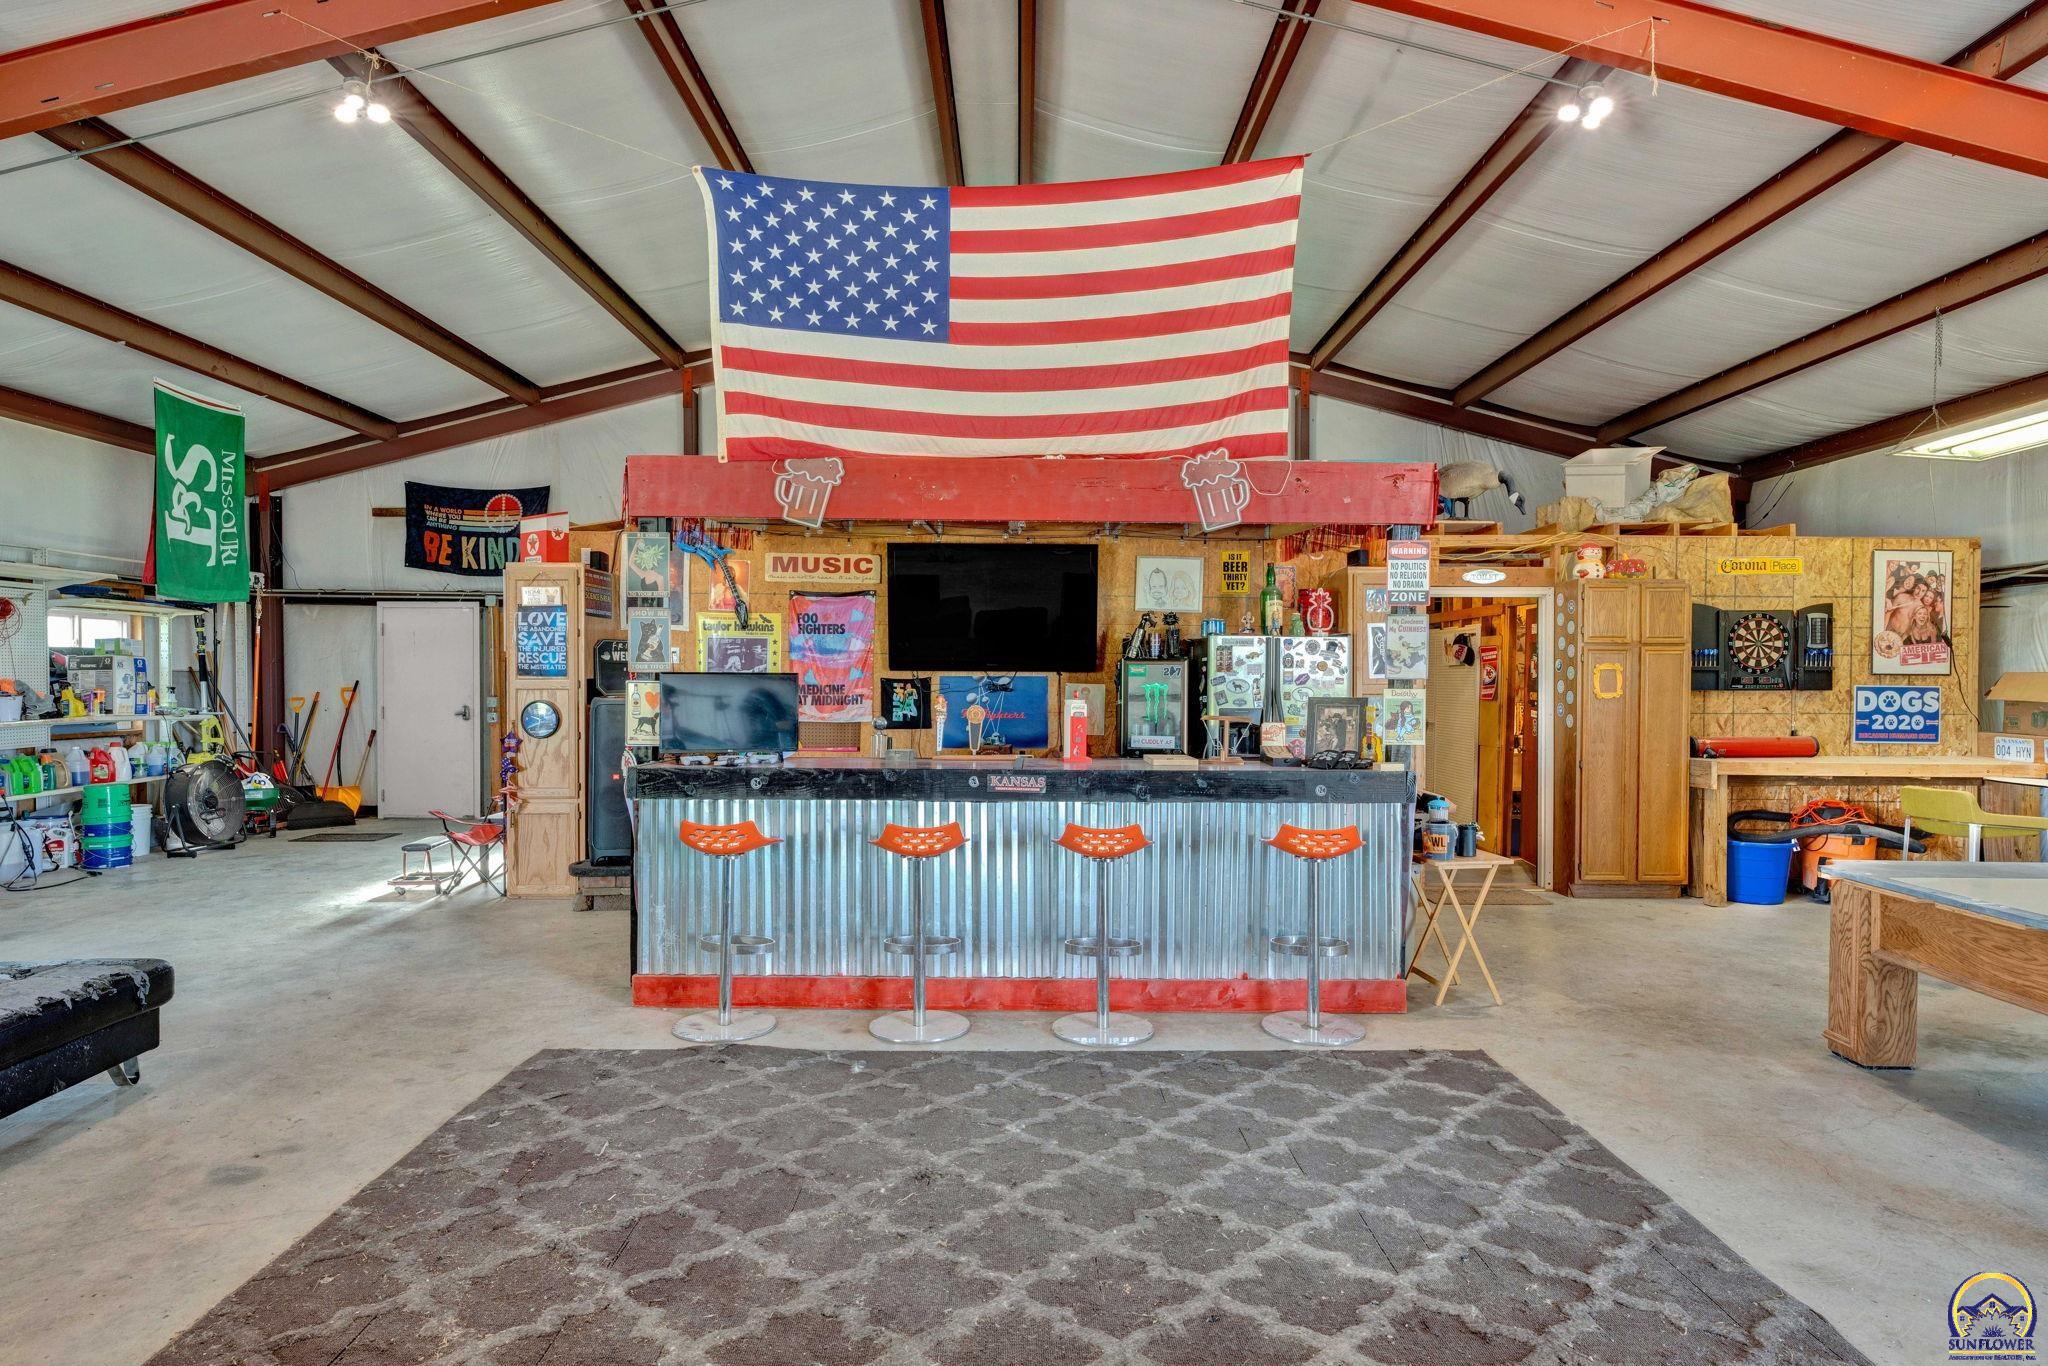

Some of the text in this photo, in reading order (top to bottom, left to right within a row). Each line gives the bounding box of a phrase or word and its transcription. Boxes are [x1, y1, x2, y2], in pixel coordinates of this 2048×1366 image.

[220, 449, 239, 567] MISSOURI
[440, 507, 463, 515] WORLD
[425, 510, 447, 518] WHERE
[426, 521, 458, 531] ANYTHING
[423, 530, 520, 570] BE KIND
[1390, 547, 1428, 555] WARNING
[1228, 553, 1243, 561] IS IT
[772, 556, 874, 575] MUSIC
[1222, 562, 1248, 572] BEER
[1390, 562, 1427, 571] NO POLITICS
[1721, 559, 1797, 574] Corona Place
[1223, 573, 1248, 581] THIRTY
[1390, 571, 1427, 580] NO RELIGION
[1226, 581, 1246, 591] YET?
[1392, 580, 1424, 589] NO DRAMA
[1390, 591, 1427, 602] ZONE
[518, 611, 567, 626] LOVE
[797, 613, 819, 624] FOO
[703, 621, 731, 633] taylor
[797, 624, 846, 635] FIGHTERS
[1397, 625, 1427, 633] GUINNESS
[517, 632, 566, 646] SAVE
[1902, 643, 1947, 655] AMERICAN
[518, 652, 567, 664] RESCUE
[1901, 651, 1948, 665] PIE
[799, 684, 846, 695] MEDICINE
[799, 694, 865, 706] AT MIDNIGHT
[1857, 690, 1940, 713] DOGS
[1871, 714, 1926, 731] 2020
[2015, 746, 2032, 759] HYN
[990, 775, 1047, 788] KANSAS
